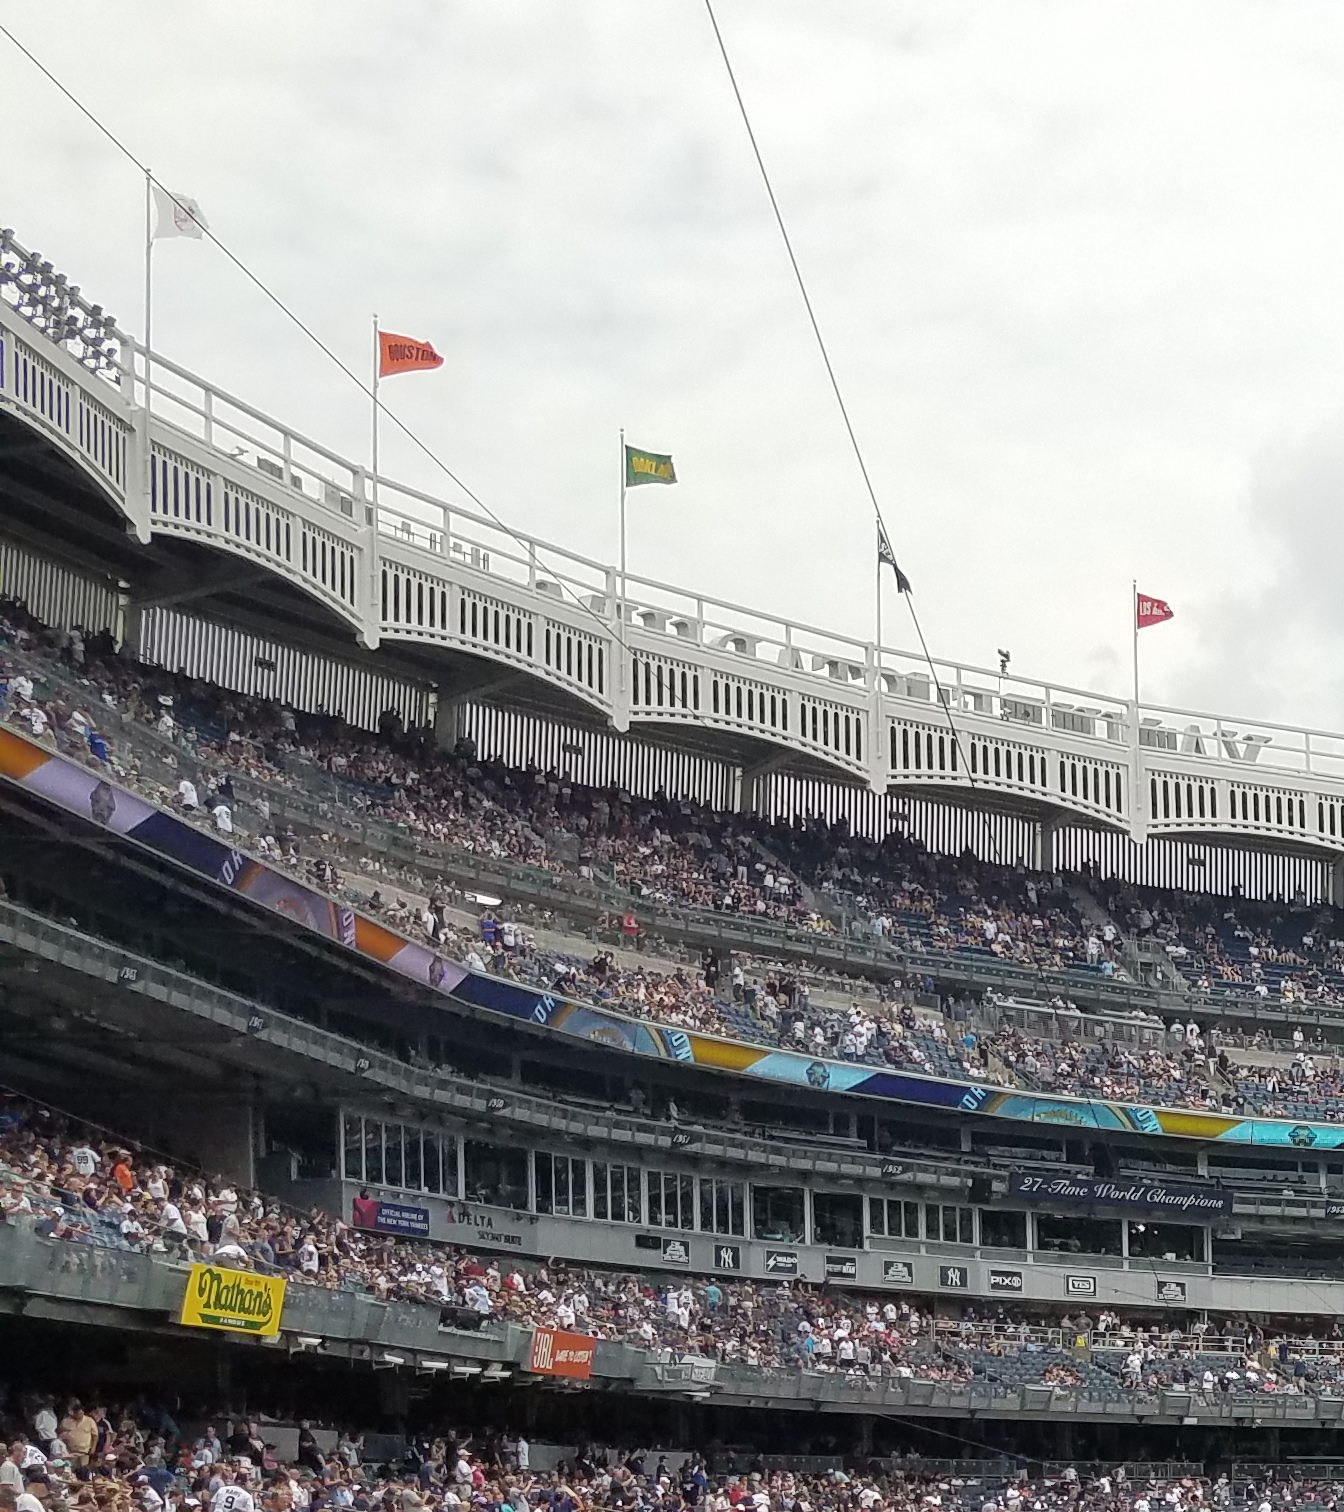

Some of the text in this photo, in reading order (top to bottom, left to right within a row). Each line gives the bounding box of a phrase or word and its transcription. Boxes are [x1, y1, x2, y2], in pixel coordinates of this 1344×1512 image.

[1019, 1176, 1224, 1211] 27-Time World Champions
[458, 1212, 493, 1229] DELTA
[198, 1268, 273, 1318] Nathan's
[533, 1332, 553, 1370] JBL
[224, 1495, 236, 1509] 9
